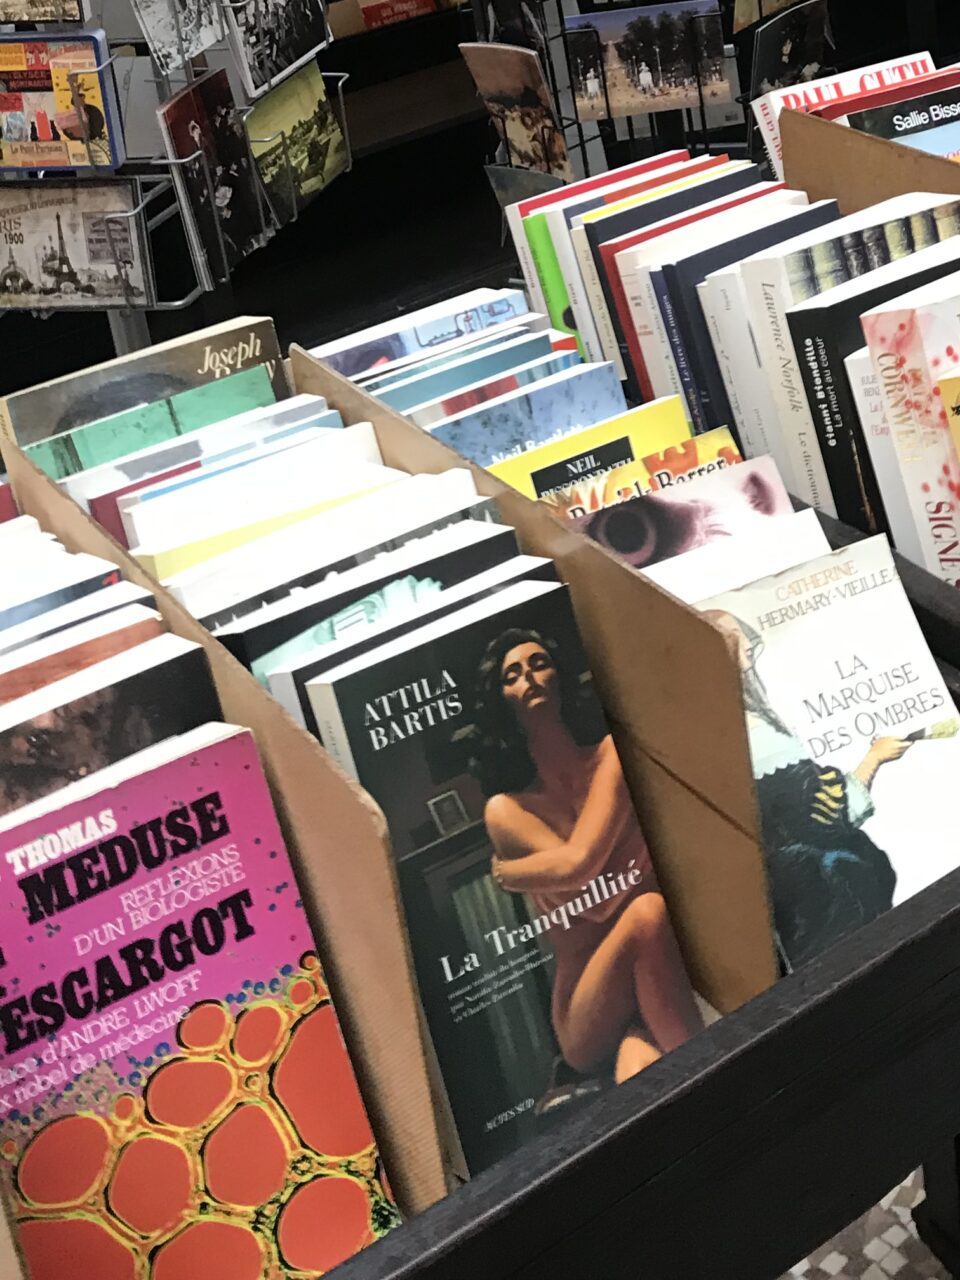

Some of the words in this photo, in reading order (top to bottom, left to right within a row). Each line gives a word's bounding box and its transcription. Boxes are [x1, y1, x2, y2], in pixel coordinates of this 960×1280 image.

[892, 111, 931, 134] Sallie
[197, 332, 261, 375] Joseph
[801, 336, 826, 400] Biondillo
[813, 334, 829, 368] coeur
[821, 368, 833, 384] au
[817, 401, 838, 447] Gianni
[825, 384, 840, 412] mort
[831, 412, 844, 428] La
[566, 453, 602, 478] NEIL
[774, 560, 859, 602] CATHERINE
[802, 662, 920, 725] MARQUISE
[834, 654, 869, 680] LA
[363, 669, 458, 726] ATTILA
[369, 693, 464, 752] BARTIS
[807, 730, 853, 760] DES
[854, 687, 946, 738] OMBRES
[5, 809, 118, 875] THOMAS
[18, 791, 231, 926] MEDUSE
[119, 843, 242, 913] REFLEXIONS
[73, 917, 126, 957] D'UN
[131, 861, 247, 932] BIOLOGISTE
[439, 953, 481, 983] La
[484, 858, 642, 957] Tranquillité
[0, 887, 256, 1056] ESCARGOT
[135, 969, 202, 1020] LWOFF
[14, 1066, 67, 1104] nobel
[70, 1049, 96, 1075] de
